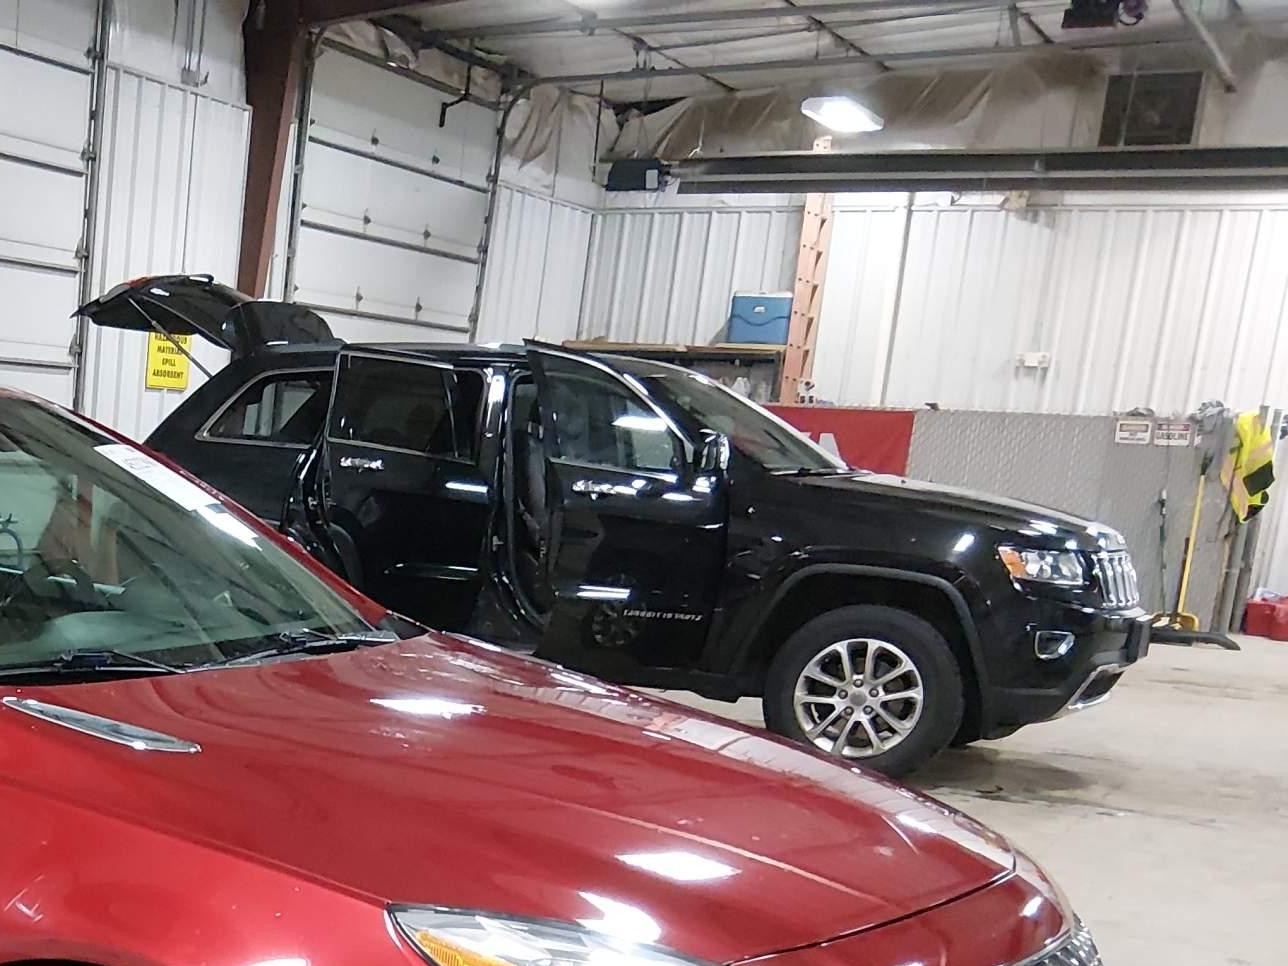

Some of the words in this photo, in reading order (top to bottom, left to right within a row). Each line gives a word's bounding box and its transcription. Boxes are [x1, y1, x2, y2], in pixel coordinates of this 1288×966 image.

[155, 333, 187, 344] HAZOUS
[162, 358, 176, 366] SPILL
[153, 369, 184, 378] ABSORBENT
